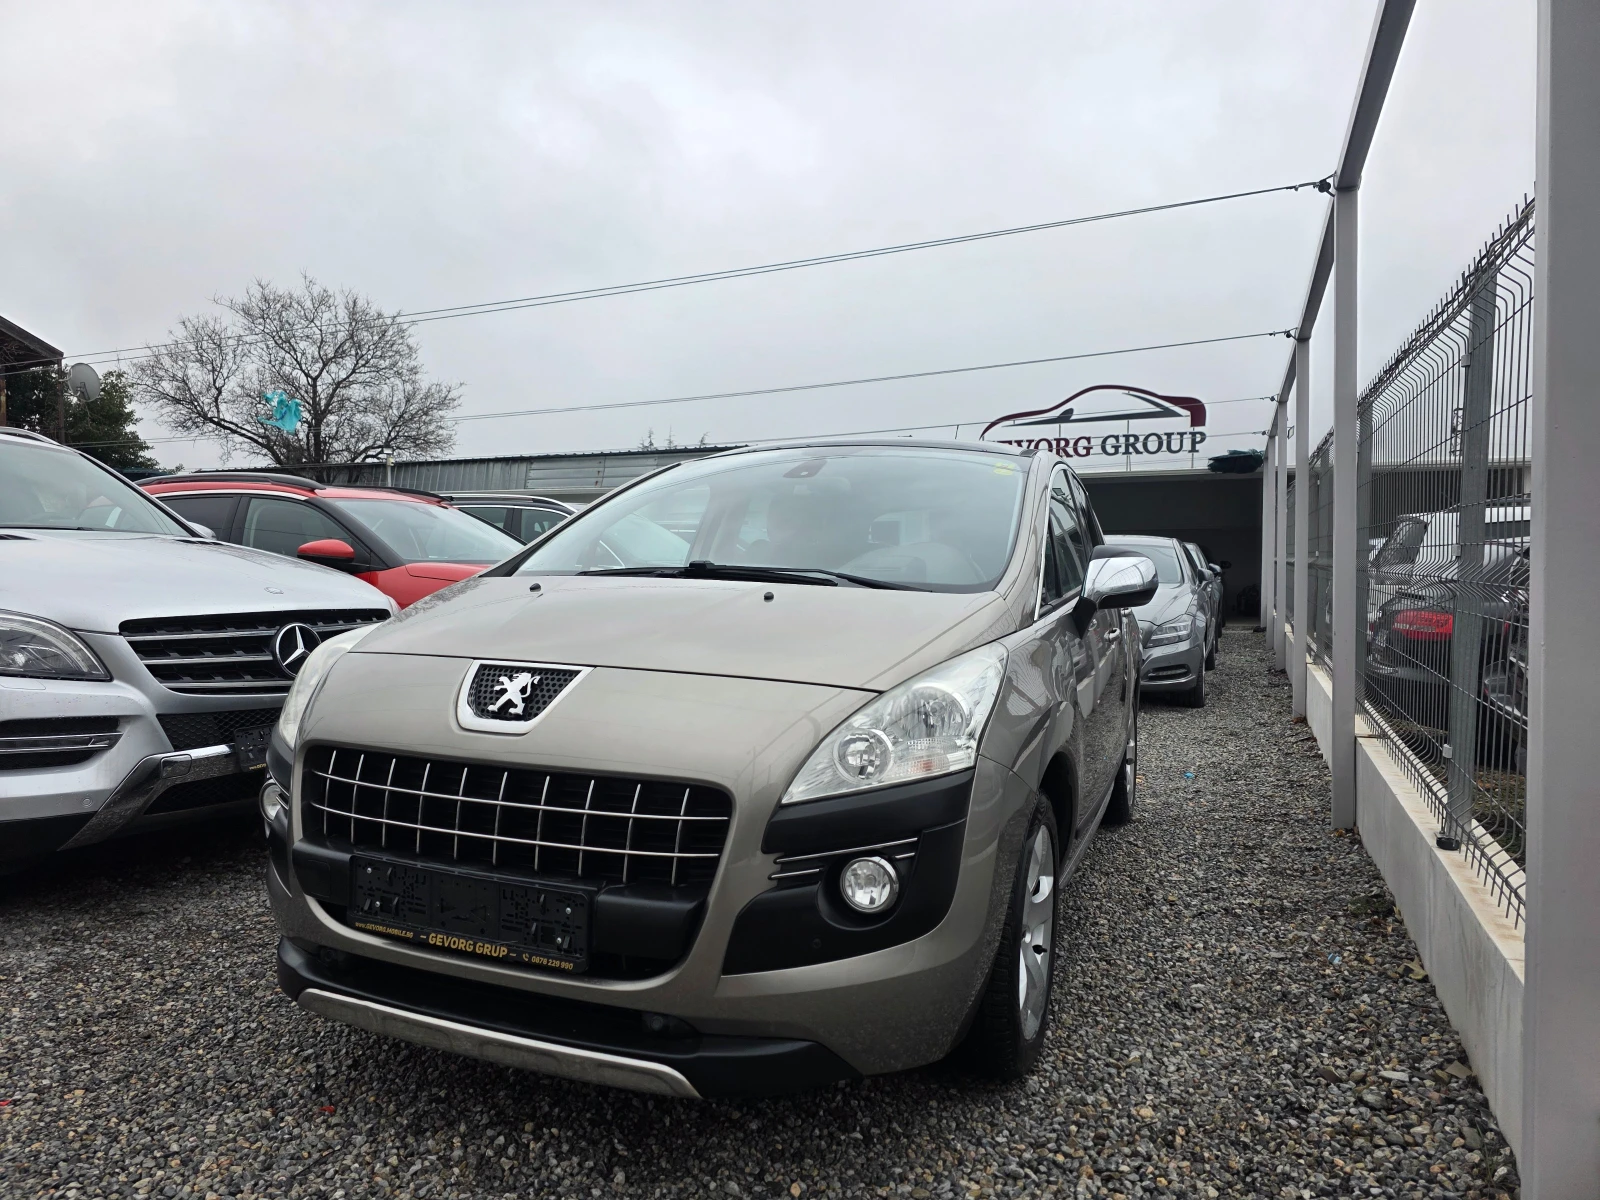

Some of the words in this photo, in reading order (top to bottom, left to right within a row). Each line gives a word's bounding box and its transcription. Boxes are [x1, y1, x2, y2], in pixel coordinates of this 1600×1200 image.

[1100, 431, 1207, 456] GROUP
[428, 932, 474, 952] GEVORG
[475, 942, 508, 958] GRUP
